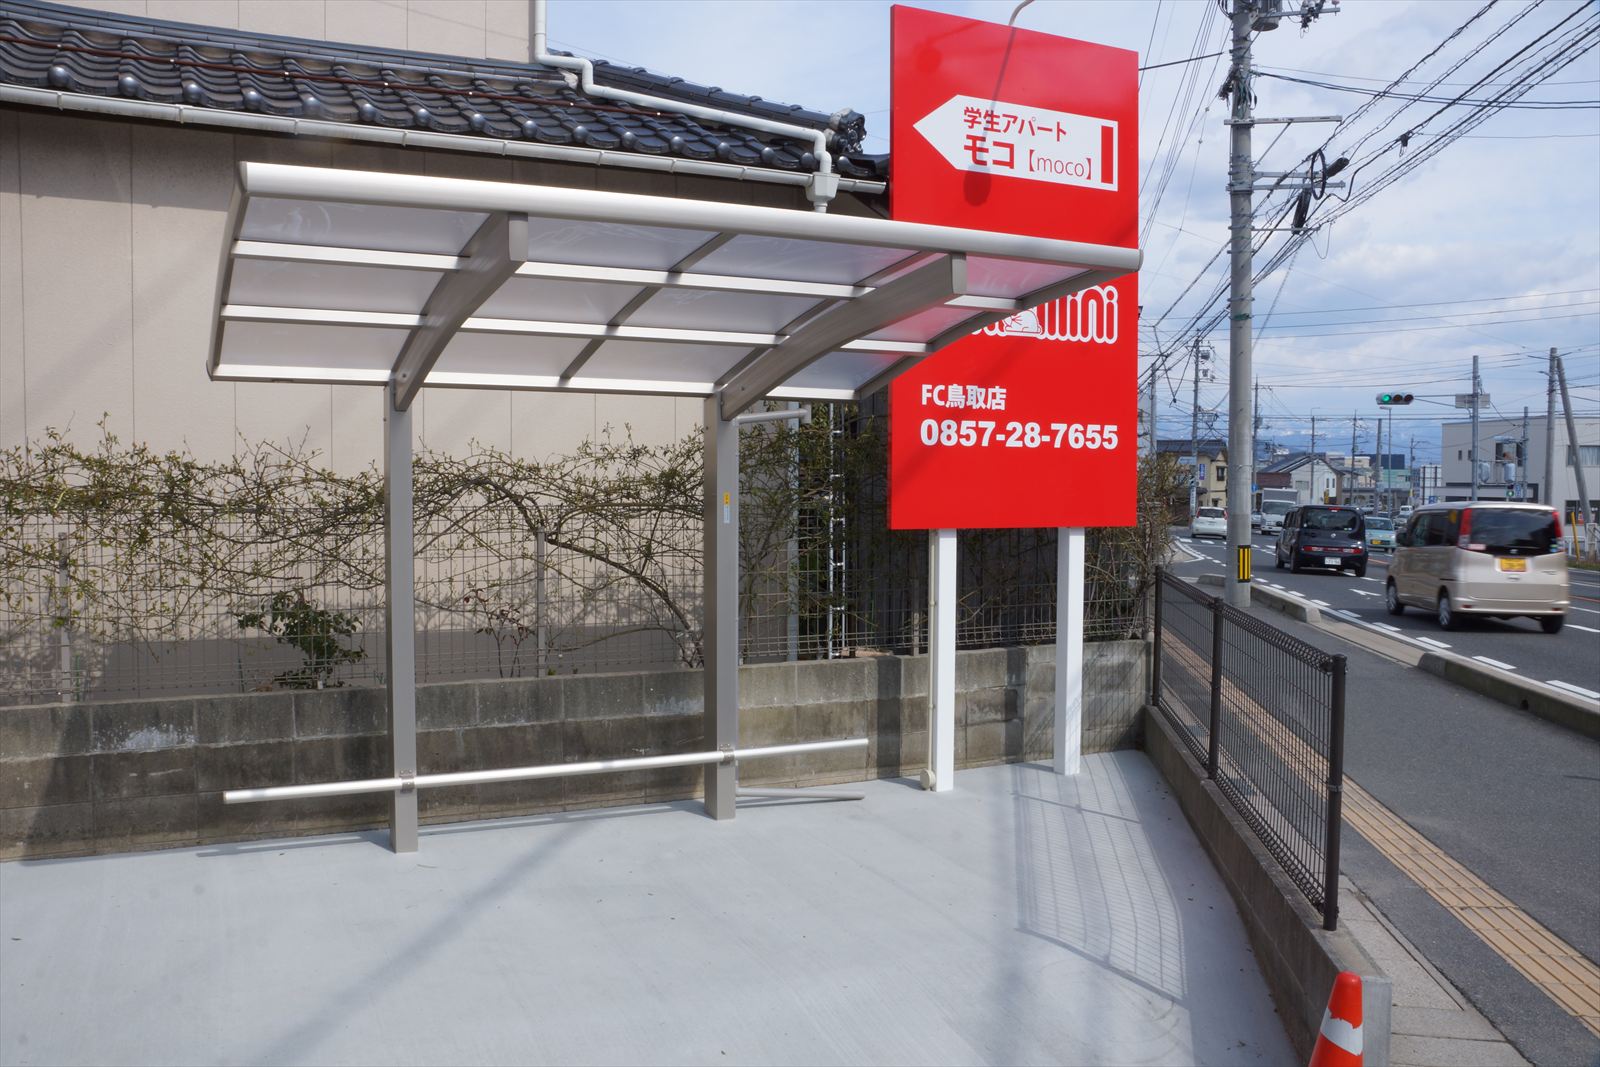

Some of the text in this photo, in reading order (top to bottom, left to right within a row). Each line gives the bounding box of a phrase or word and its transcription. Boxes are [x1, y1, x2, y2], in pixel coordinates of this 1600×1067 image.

[963, 106, 1067, 142] 学生アパート
[963, 134, 1015, 169] モコ
[921, 384, 1007, 411] FC鳥取店
[920, 418, 1119, 450] 0857-28-7655
